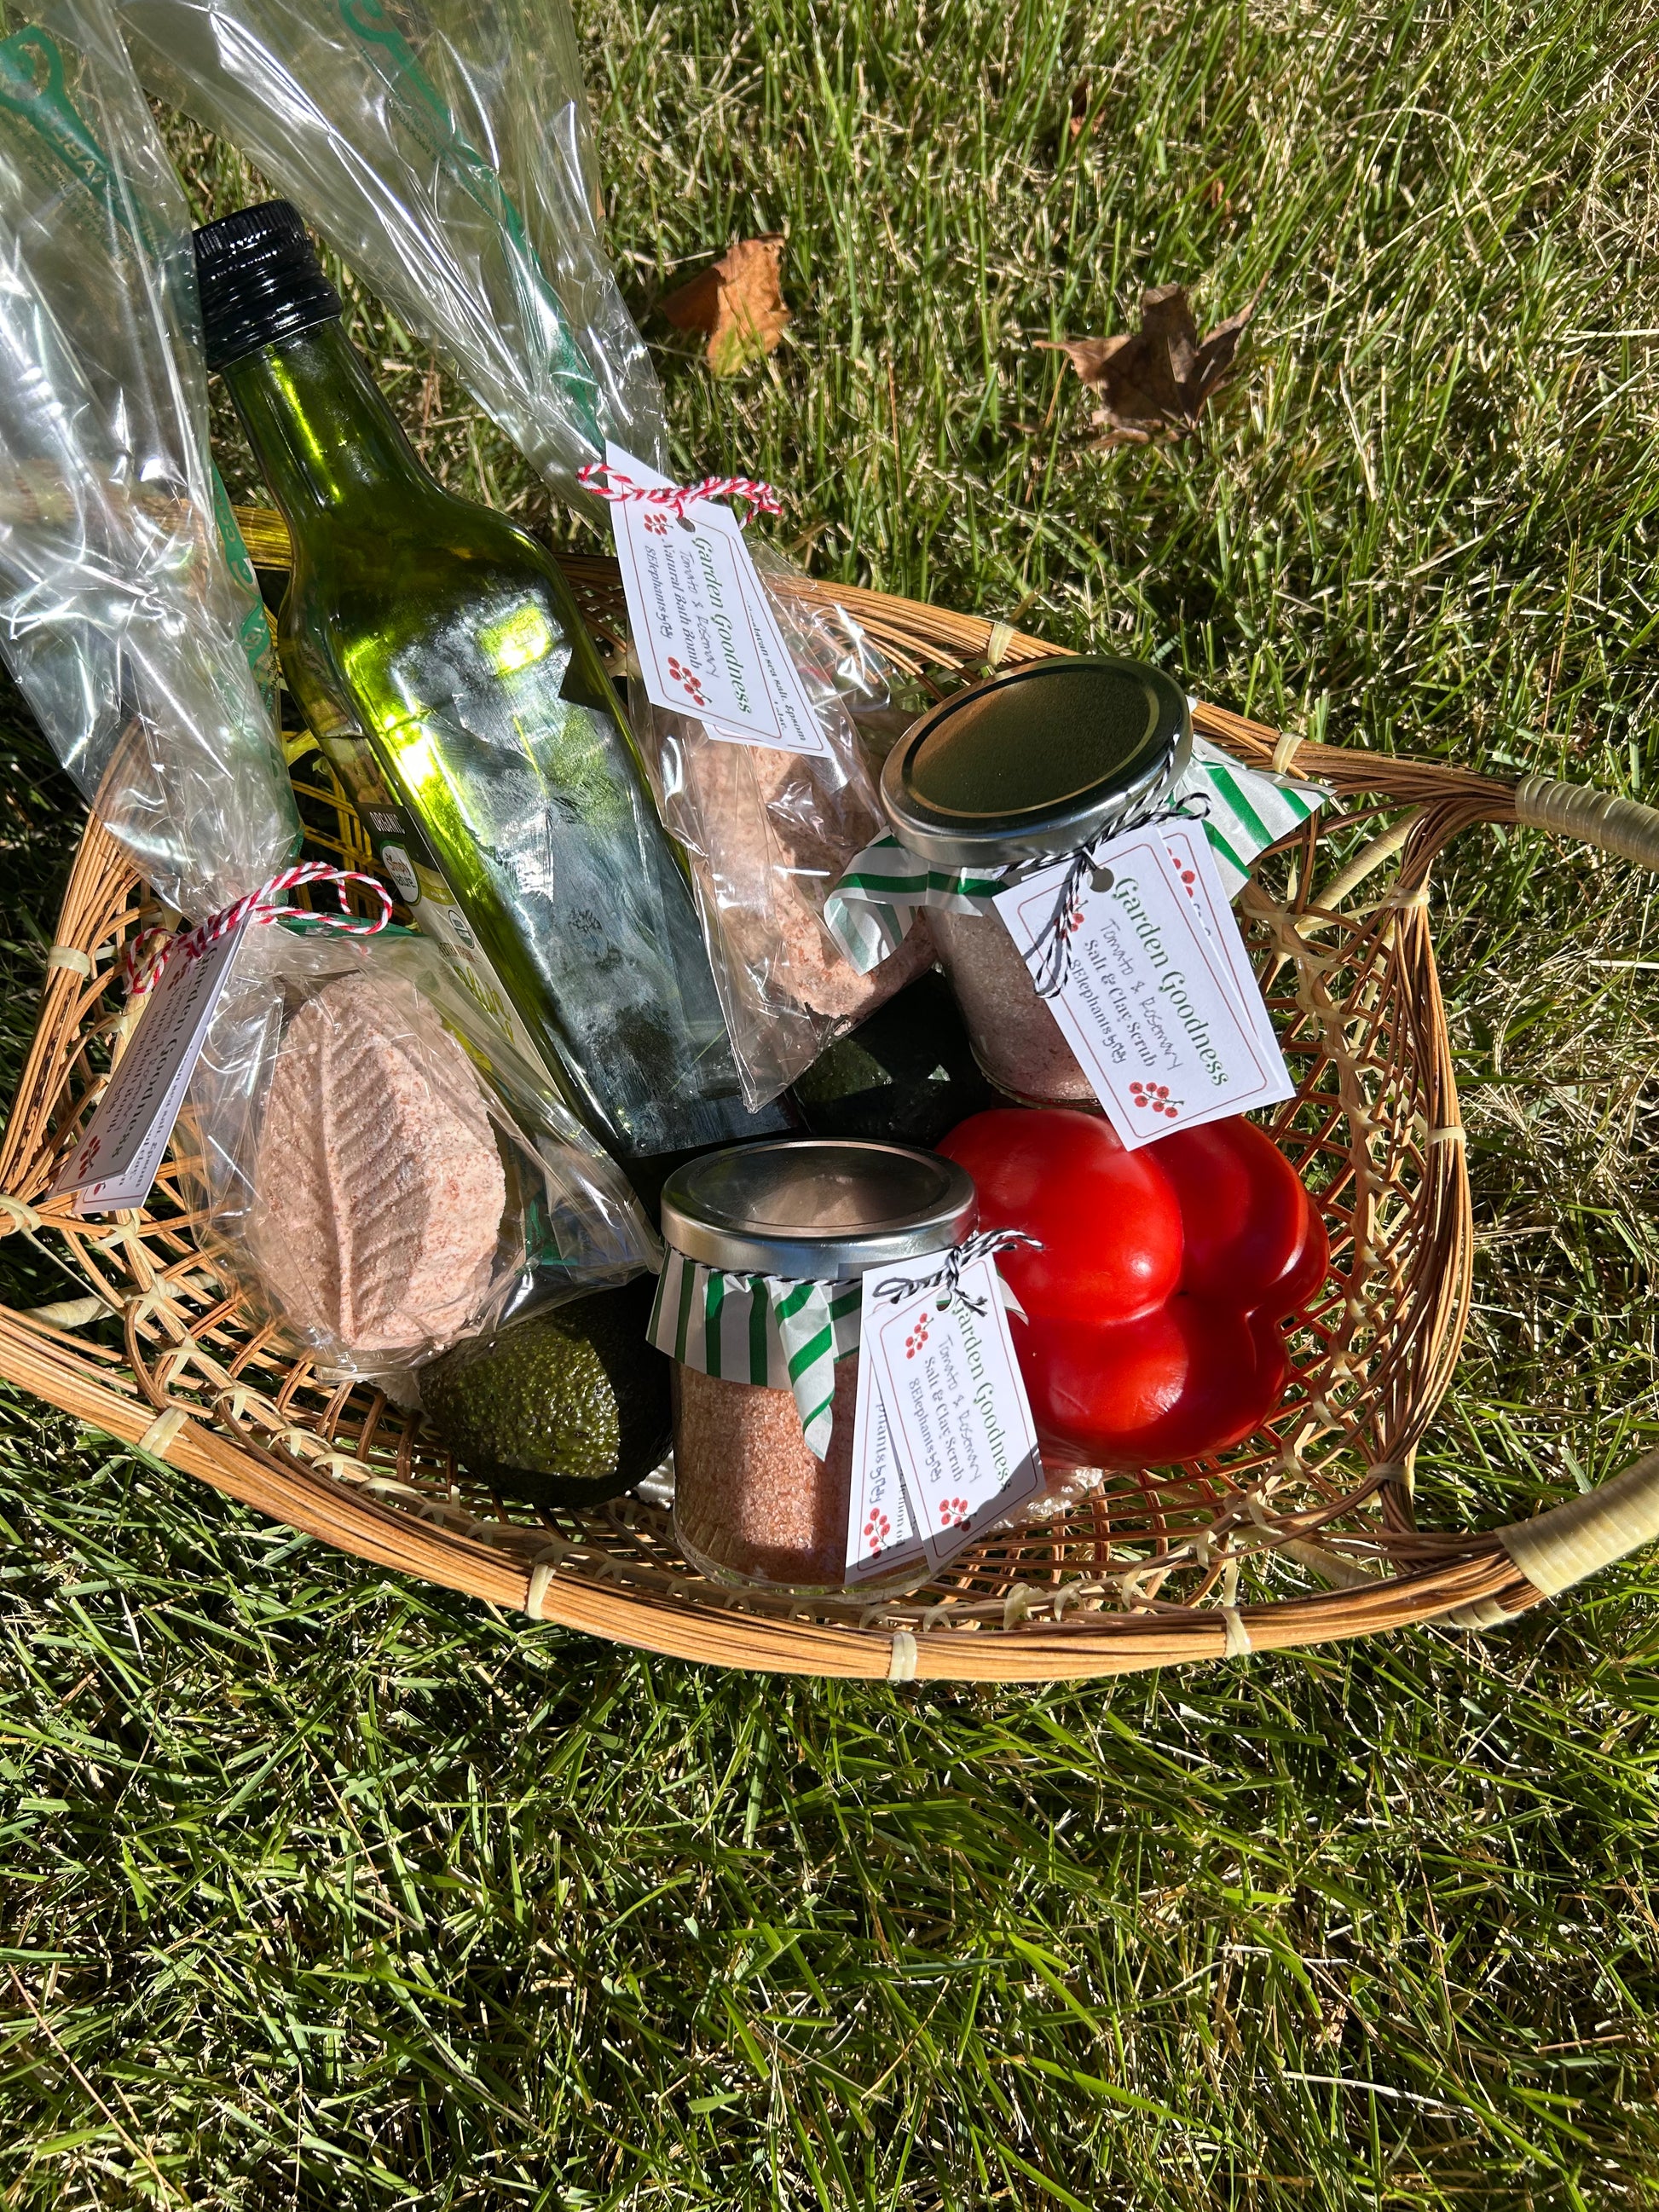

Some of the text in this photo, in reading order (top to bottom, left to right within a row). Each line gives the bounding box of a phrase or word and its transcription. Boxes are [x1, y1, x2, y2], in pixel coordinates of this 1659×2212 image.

[645, 546, 666, 612] 8Elephants
[662, 539, 702, 668] Natural Bath Bomb
[679, 552, 698, 593] Tomato
[696, 615, 720, 678] Rosemary
[691, 538, 752, 713] Garden Goodness
[765, 659, 777, 676] sea
[785, 705, 806, 747] Epsom
[369, 811, 406, 835] ORGANIC
[1084, 939, 1157, 1066] Salt & Clay Scrub
[1101, 919, 1183, 1071] Tomato & Rosemary
[1111, 878, 1228, 1086] Garden Goodness
[112, 945, 219, 1160] Garden Goodness
[131, 1048, 152, 1083] Bath
[875, 1403, 885, 1464] phants
[909, 1378, 935, 1453] 8Elephants
[925, 1357, 964, 1481] Salt & Clay Scrub
[939, 1335, 981, 1482] Tomato & Rosemary
[968, 1380, 1015, 1495] Goodness
